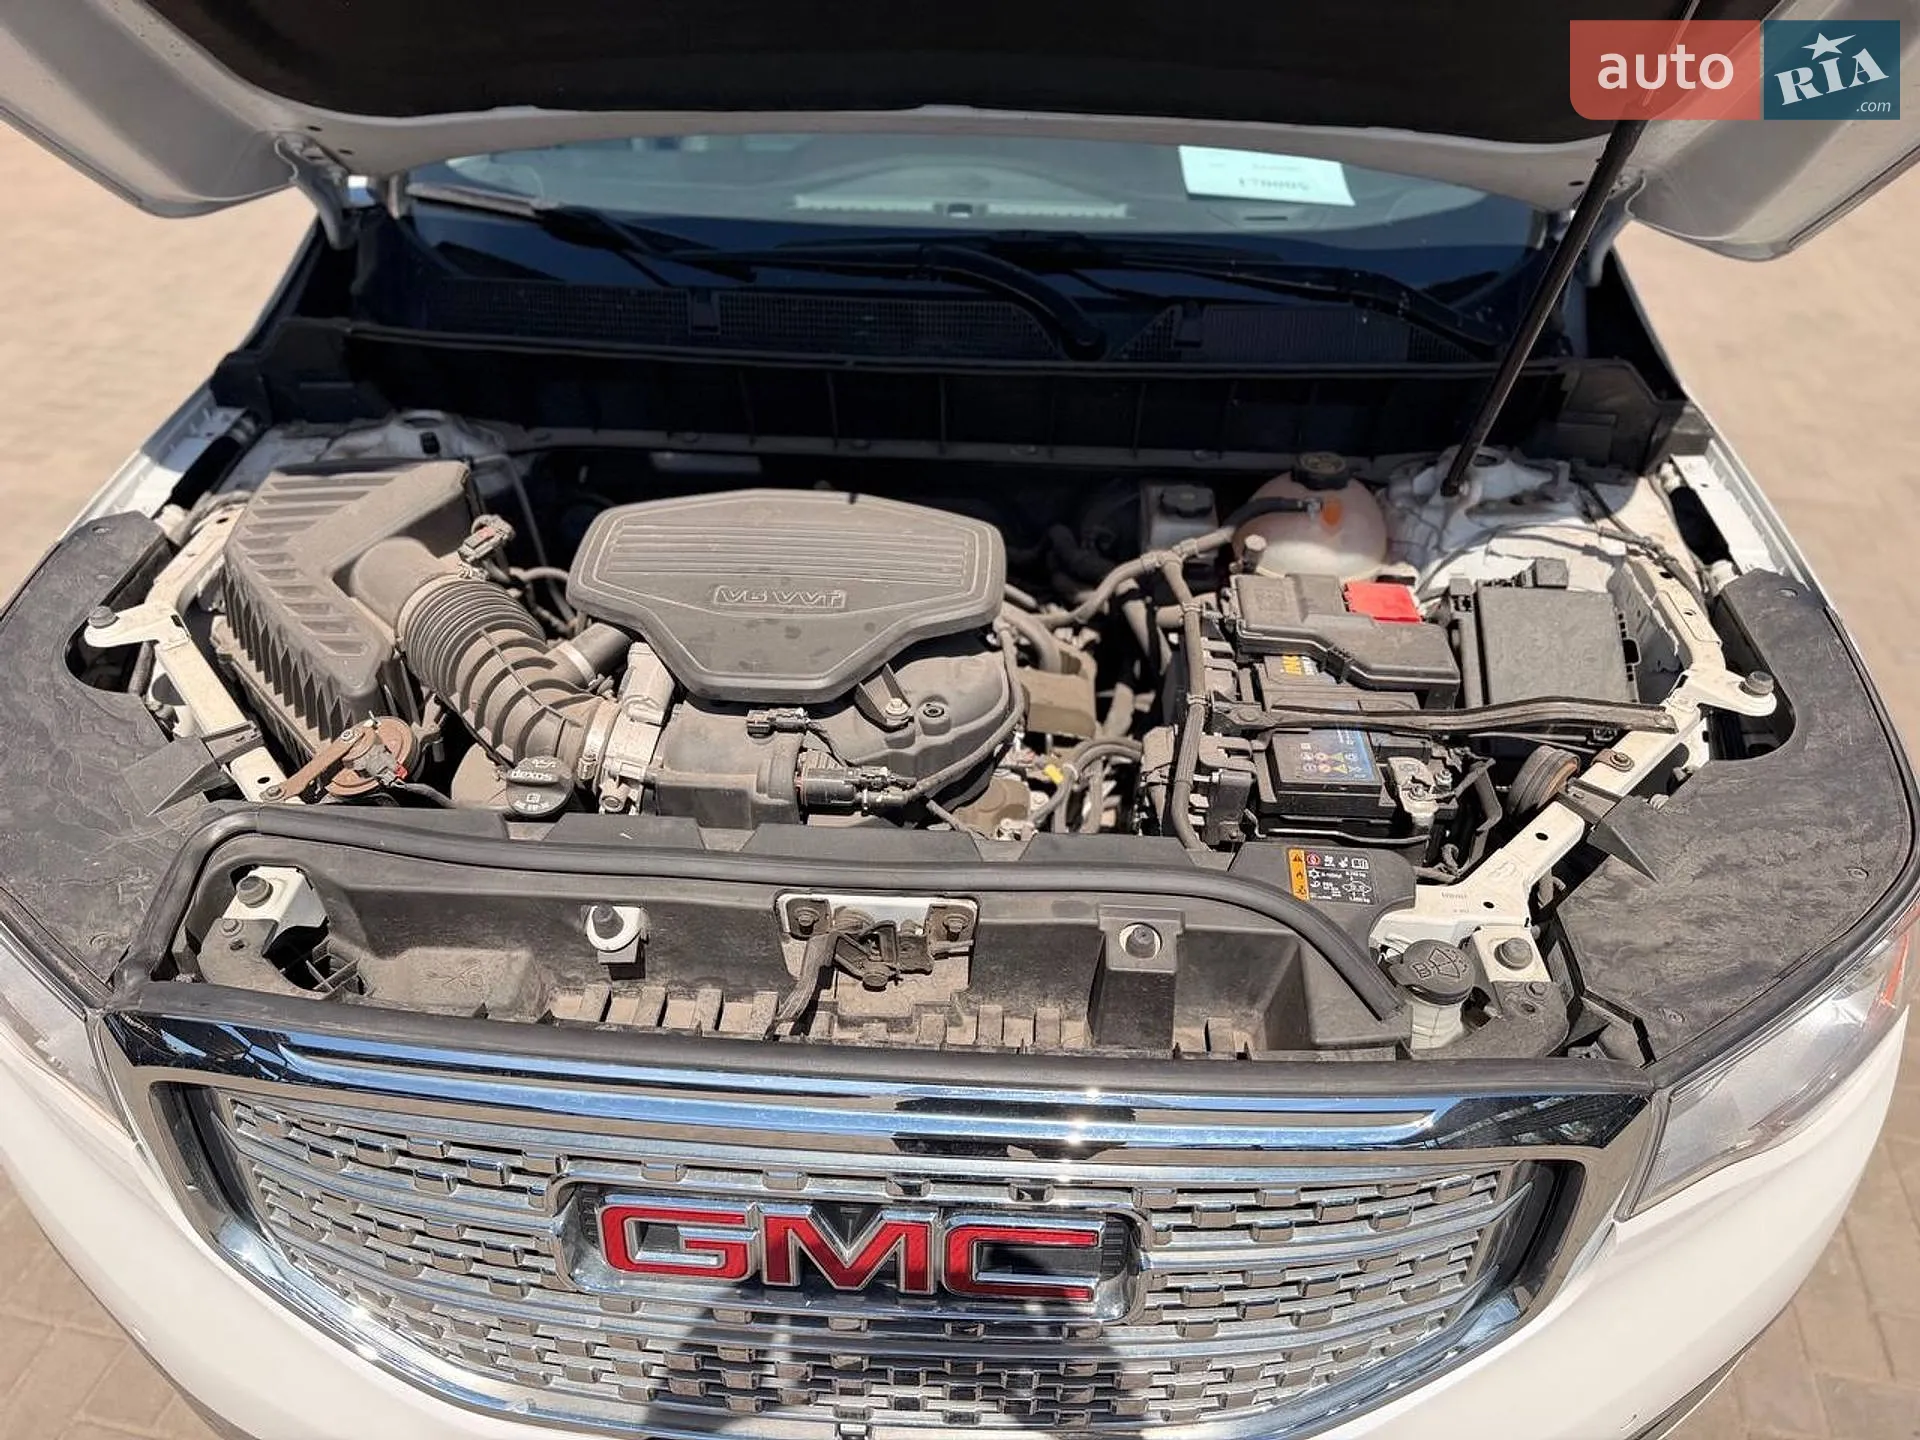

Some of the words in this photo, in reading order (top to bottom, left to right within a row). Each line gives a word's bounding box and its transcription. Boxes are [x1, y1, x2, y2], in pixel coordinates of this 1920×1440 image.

[773, 590, 842, 607] VVT
[511, 769, 553, 781] dexos
[600, 1194, 1105, 1301] GMC
